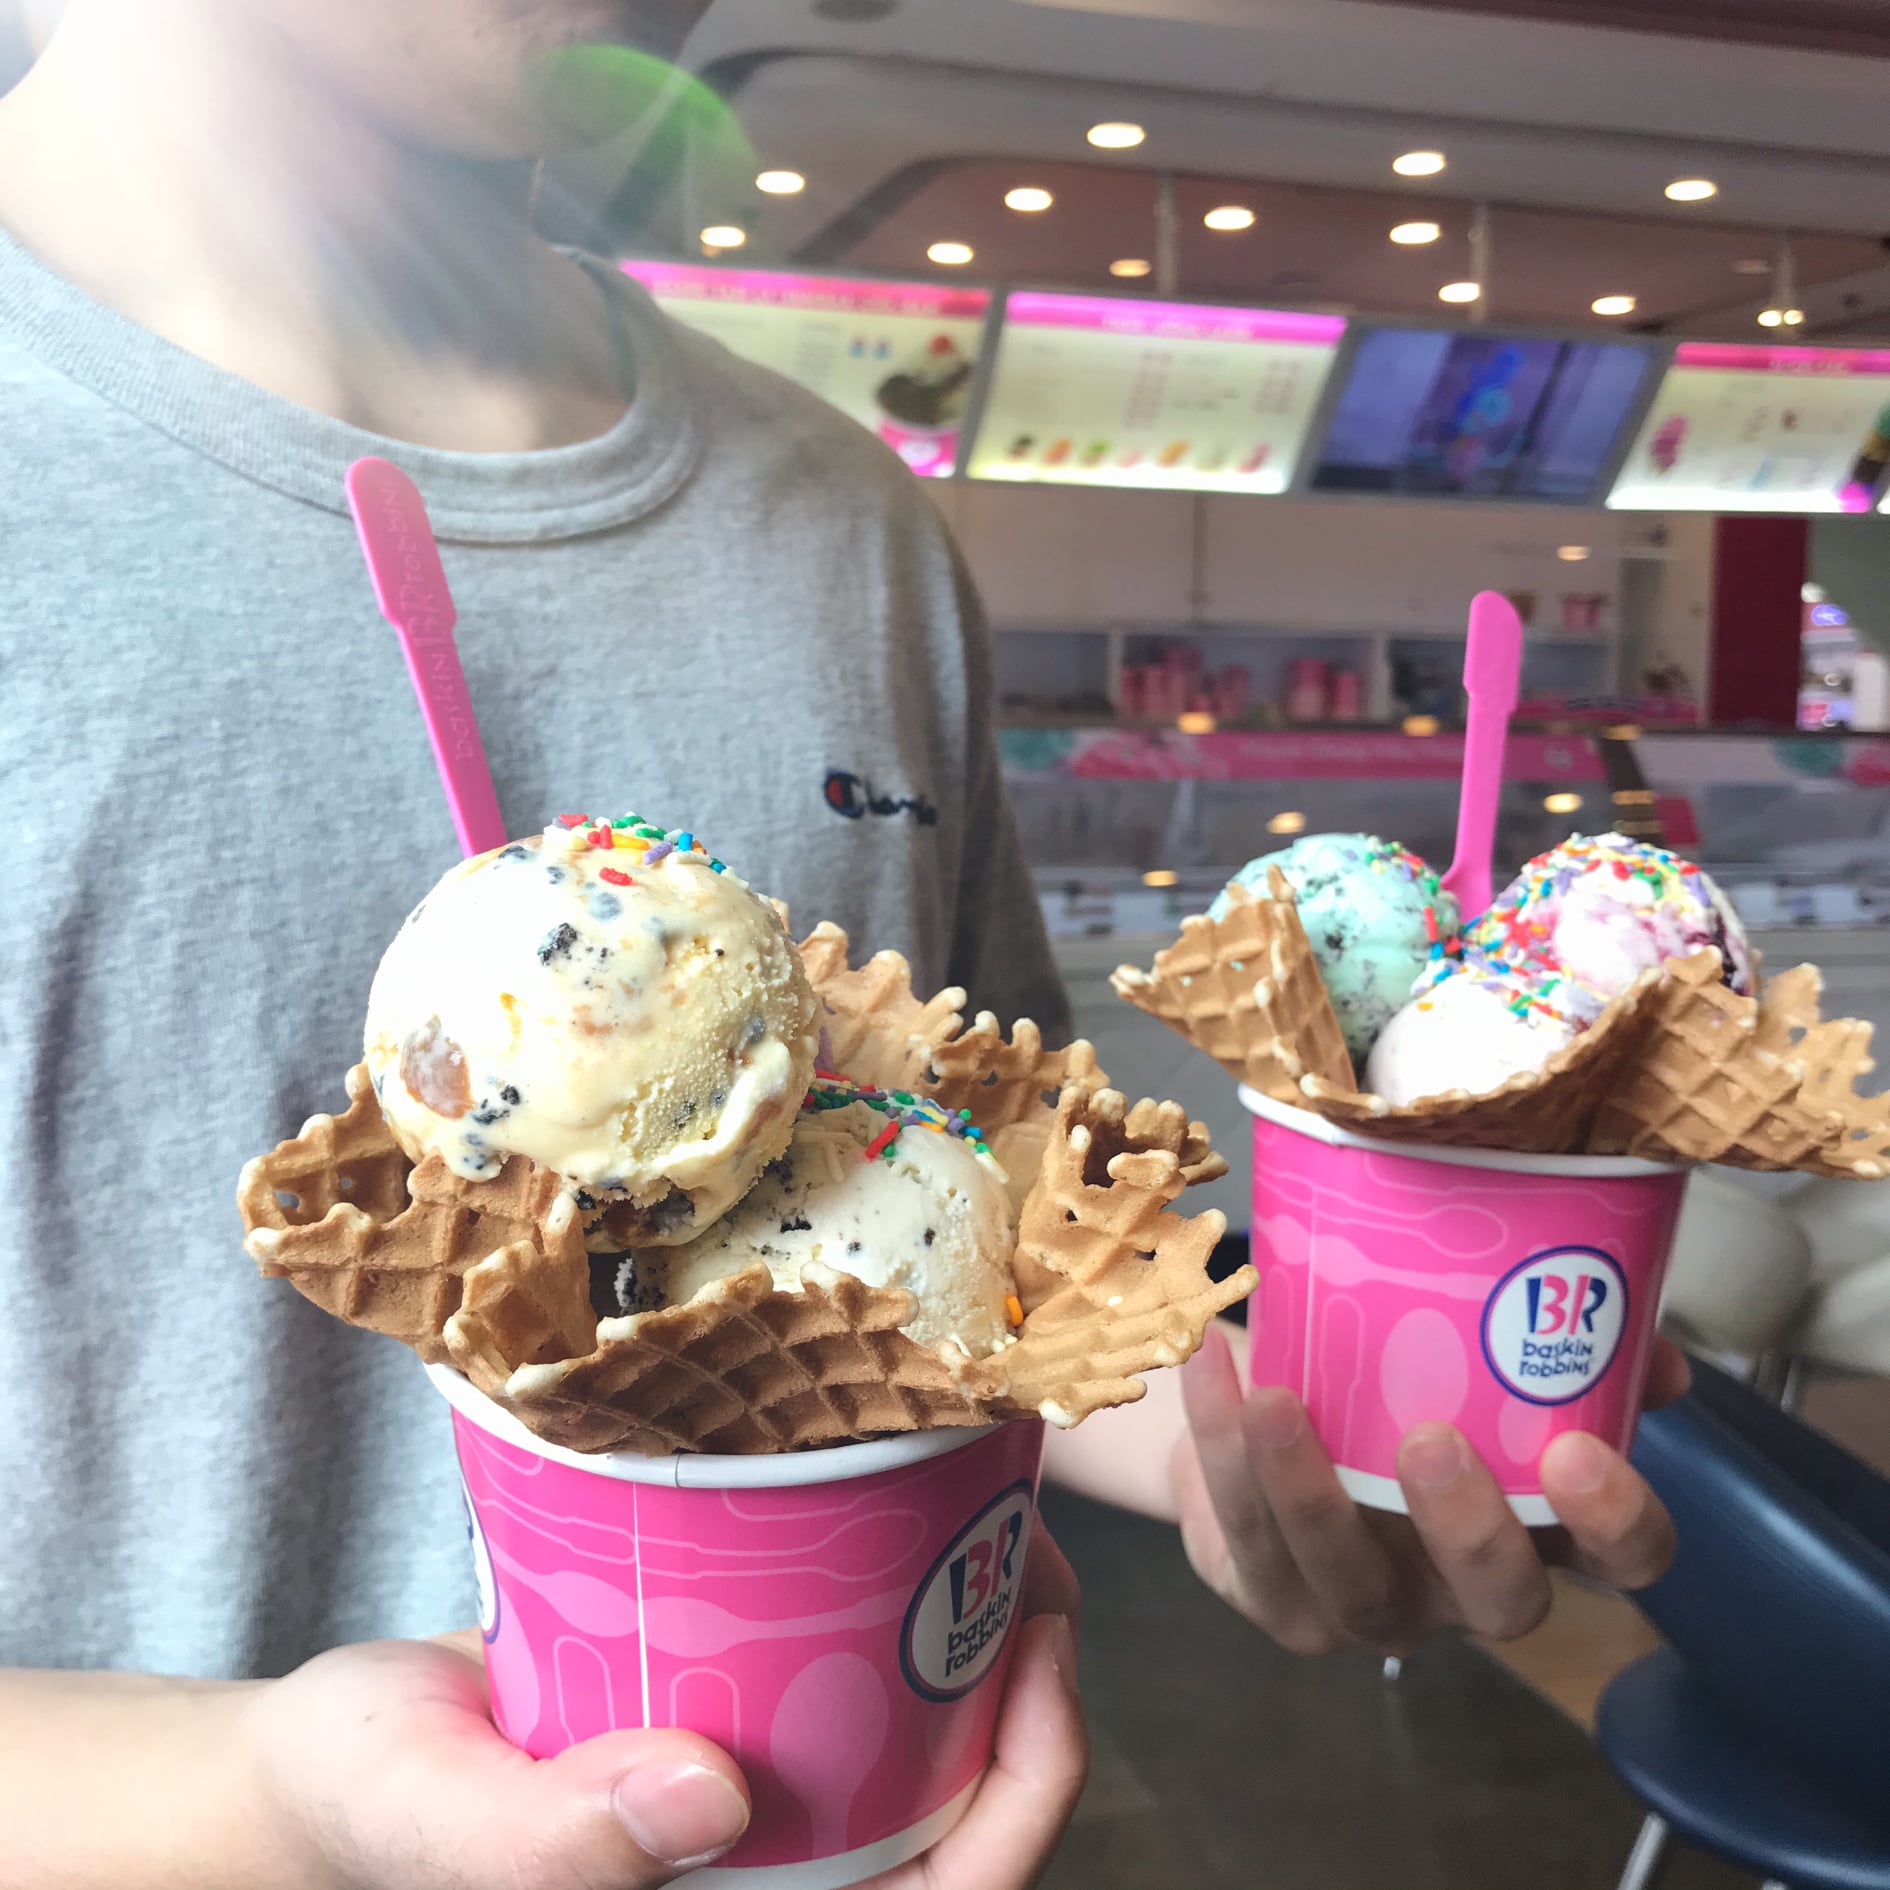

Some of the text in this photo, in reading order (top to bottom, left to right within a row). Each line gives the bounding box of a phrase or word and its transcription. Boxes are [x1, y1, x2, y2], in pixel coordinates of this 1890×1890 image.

[382, 478, 425, 582] robbin
[1525, 1273, 1607, 1335] BR
[1519, 1359, 1590, 1378] robbins
[1522, 1338, 1593, 1359] baskin
[949, 1510, 1022, 1625] BR
